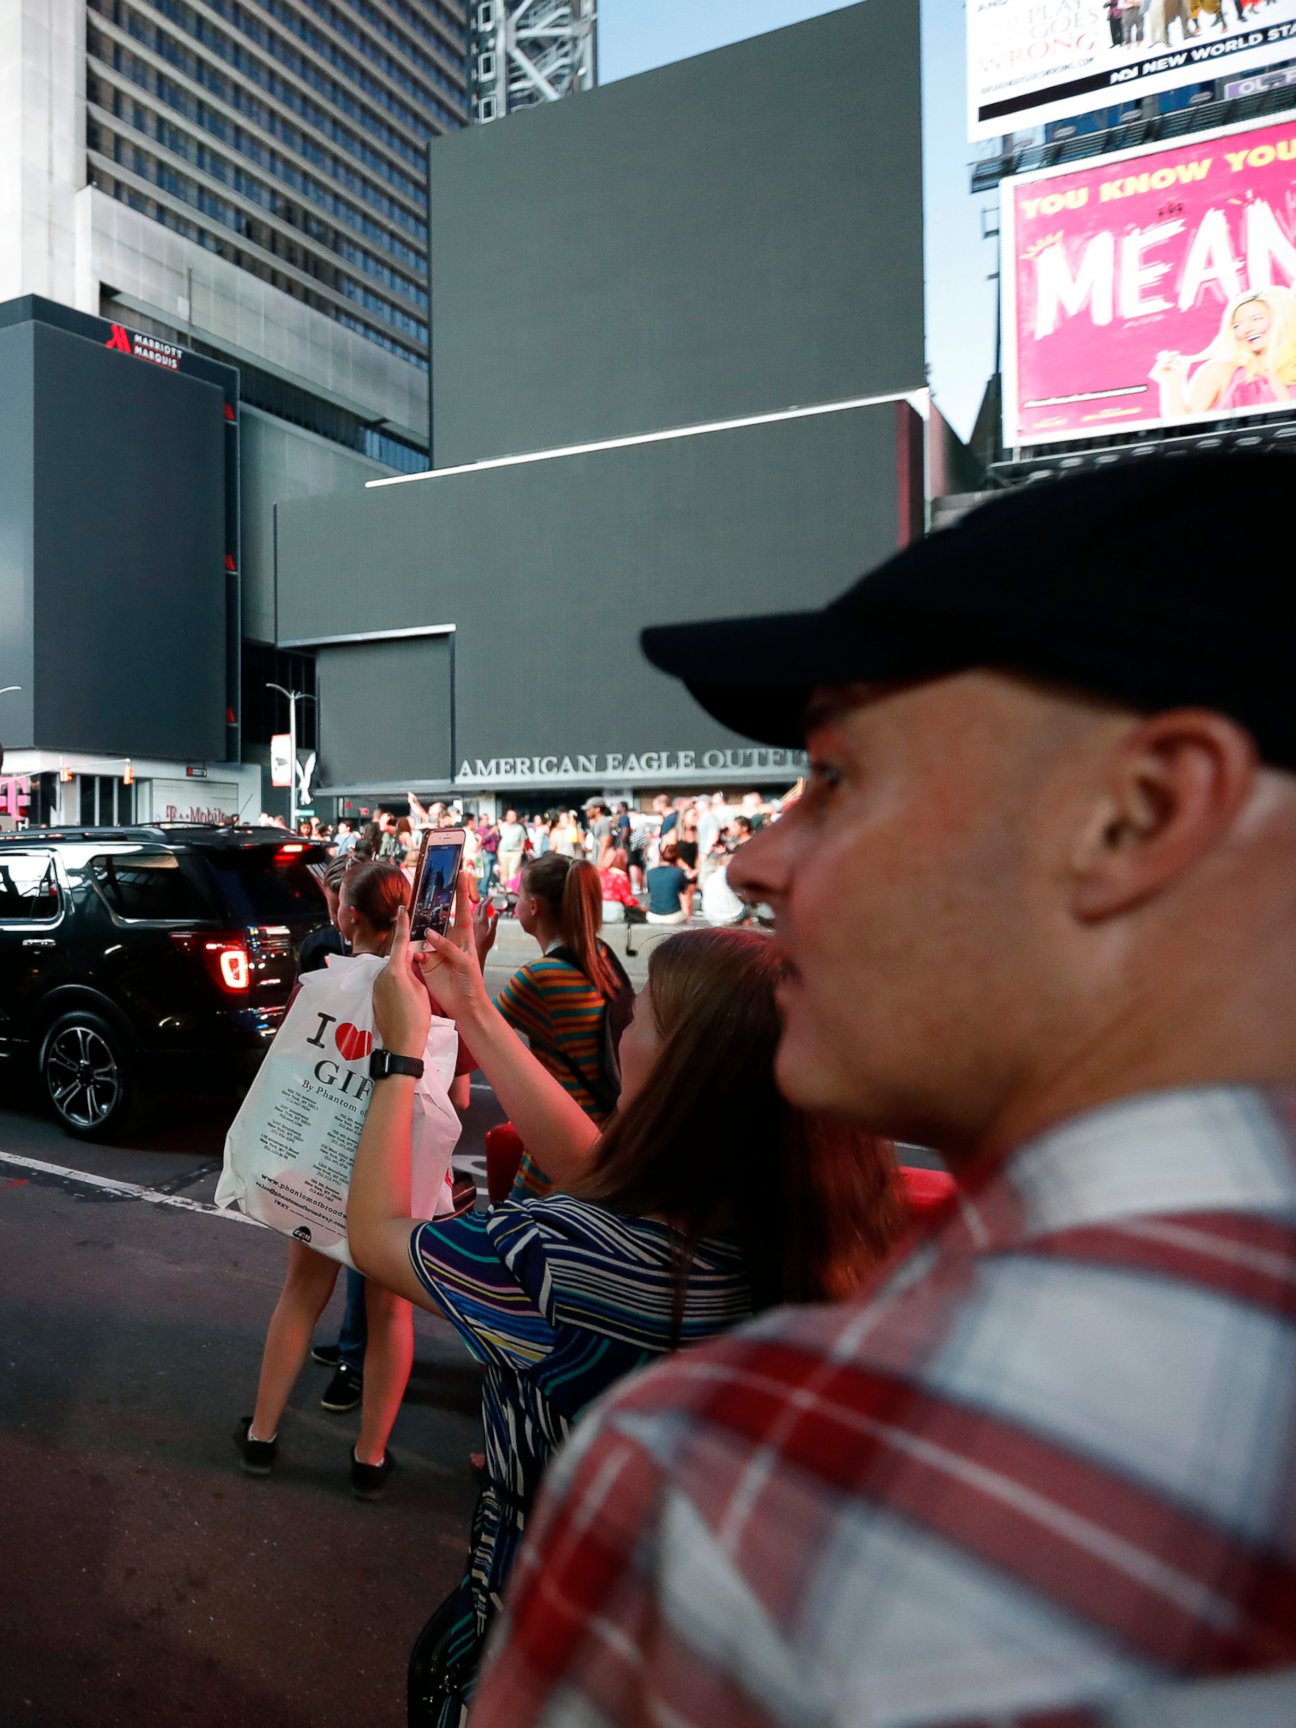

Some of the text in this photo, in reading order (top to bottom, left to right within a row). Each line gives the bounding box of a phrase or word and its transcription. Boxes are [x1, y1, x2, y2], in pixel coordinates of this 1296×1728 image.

[979, 31, 1100, 73] WRONG
[1142, 52, 1188, 76] NEW
[1191, 33, 1263, 60] WORLD
[1019, 187, 1089, 219] YOU
[1099, 157, 1213, 203] KNOW
[134, 334, 183, 359] MARRIOTT
[134, 345, 178, 369] MARQUIS
[459, 754, 598, 778] AMERICAN
[605, 750, 695, 773] EAGLE
[306, 1011, 337, 1049] I
[302, 1079, 314, 1093] By
[316, 1086, 358, 1113] Phantom
